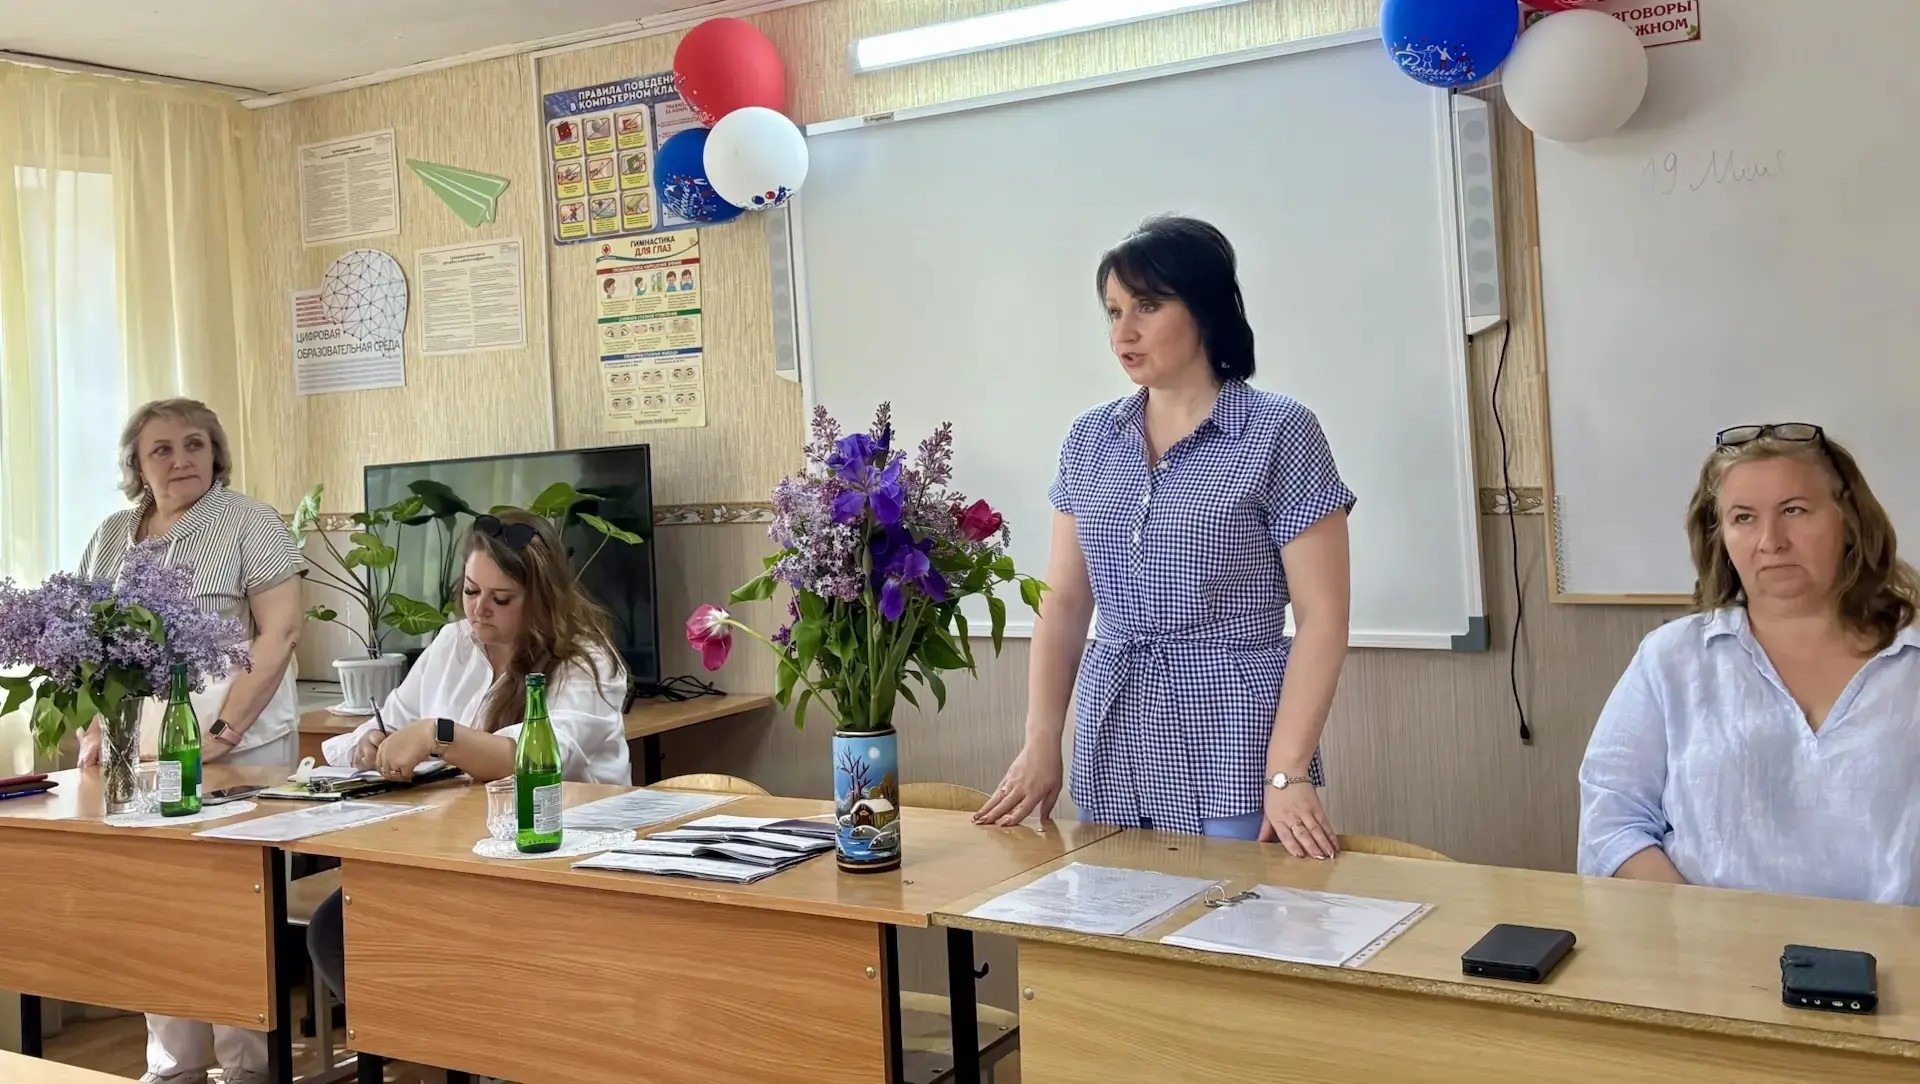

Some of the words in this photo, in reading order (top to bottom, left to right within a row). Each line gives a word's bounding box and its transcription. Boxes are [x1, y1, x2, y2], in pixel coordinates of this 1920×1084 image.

[1629, 18, 1688, 36] ЖНОМ
[570, 103, 576, 111] В
[579, 90, 651, 110] КОМПЬТЕРНОМ
[578, 85, 622, 100] ПРАВИЛА
[1642, 152, 1678, 195] 19
[630, 235, 675, 248] ГИМНАСТИКА
[635, 246, 652, 257] ДЛЯ
[652, 244, 672, 254] ГЛАЗ
[296, 328, 341, 344] ЦИФРОВАЯ
[297, 342, 372, 359] ОБРАЗОВАТЕЛЬНАЯ
[373, 340, 401, 352] СРЕДА
